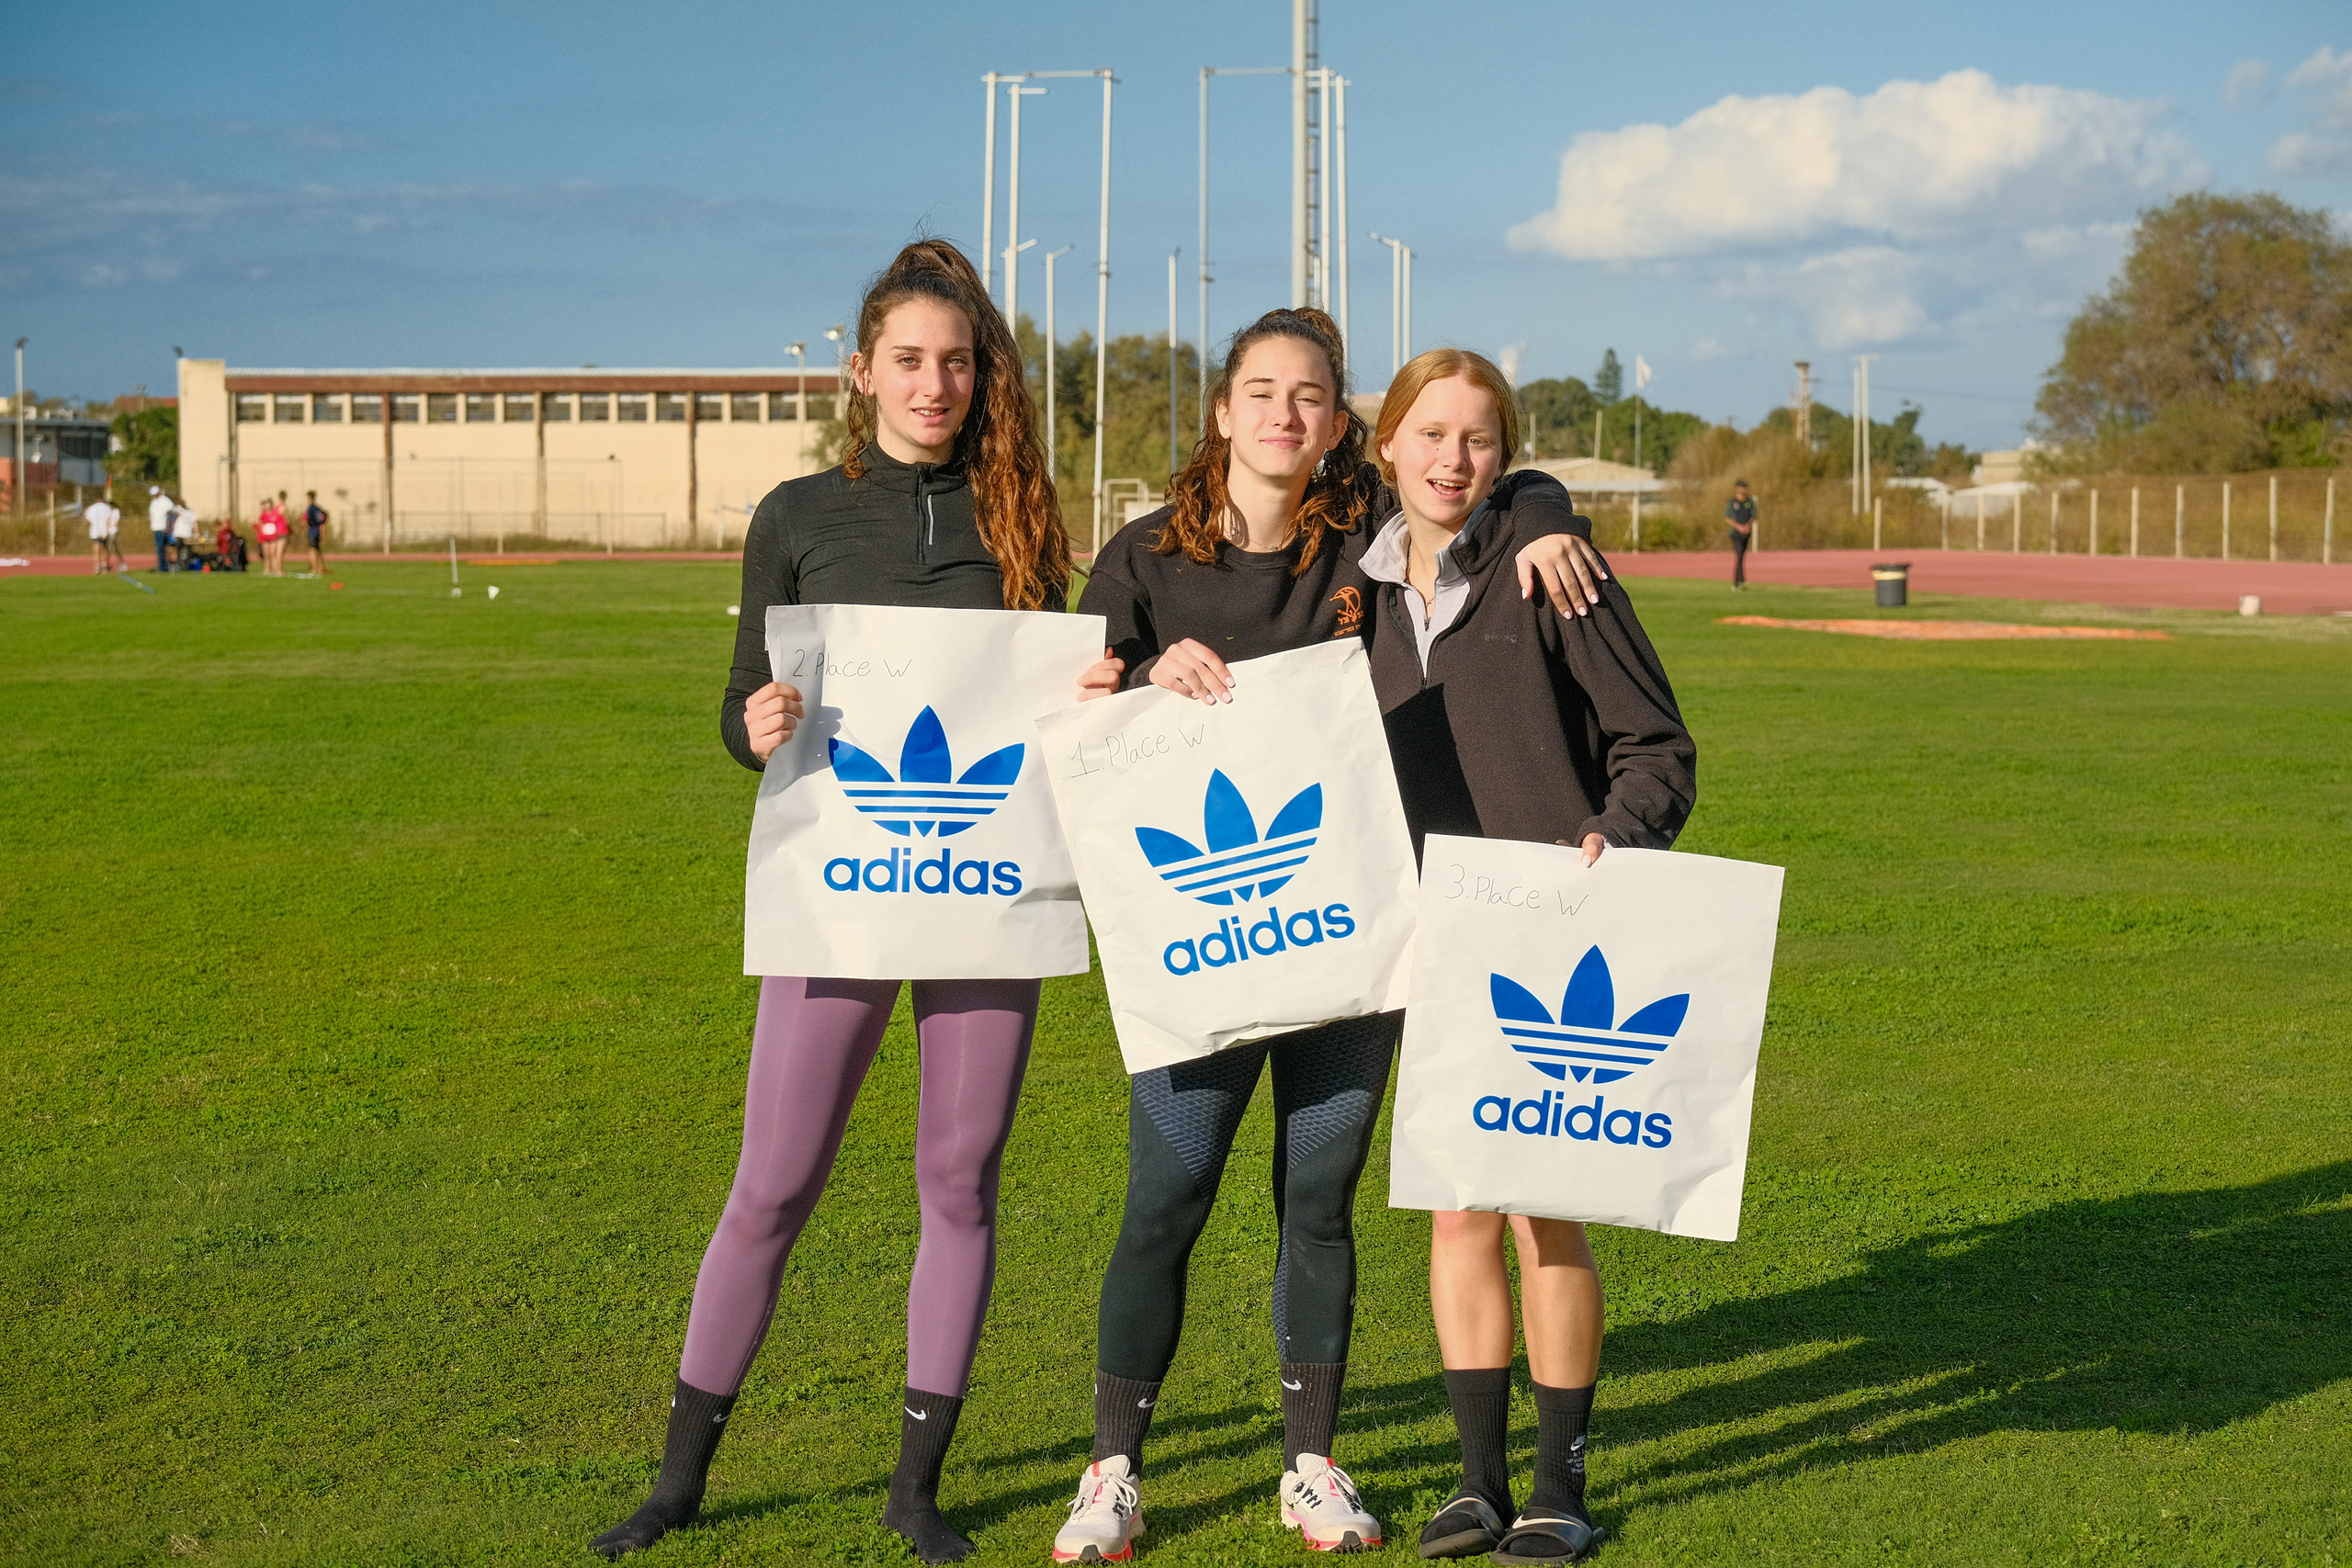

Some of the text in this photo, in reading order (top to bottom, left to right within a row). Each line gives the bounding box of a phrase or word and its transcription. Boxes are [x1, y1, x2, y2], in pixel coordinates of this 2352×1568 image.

[792, 648, 809, 678] 2.
[814, 651, 872, 678] Place
[1105, 732, 1170, 767] Place
[823, 847, 1023, 897] adidas
[1443, 863, 1469, 899] 3.
[1474, 875, 1541, 909] Place
[1163, 903, 1356, 976] adidas
[1473, 1089, 1672, 1149] adidas
